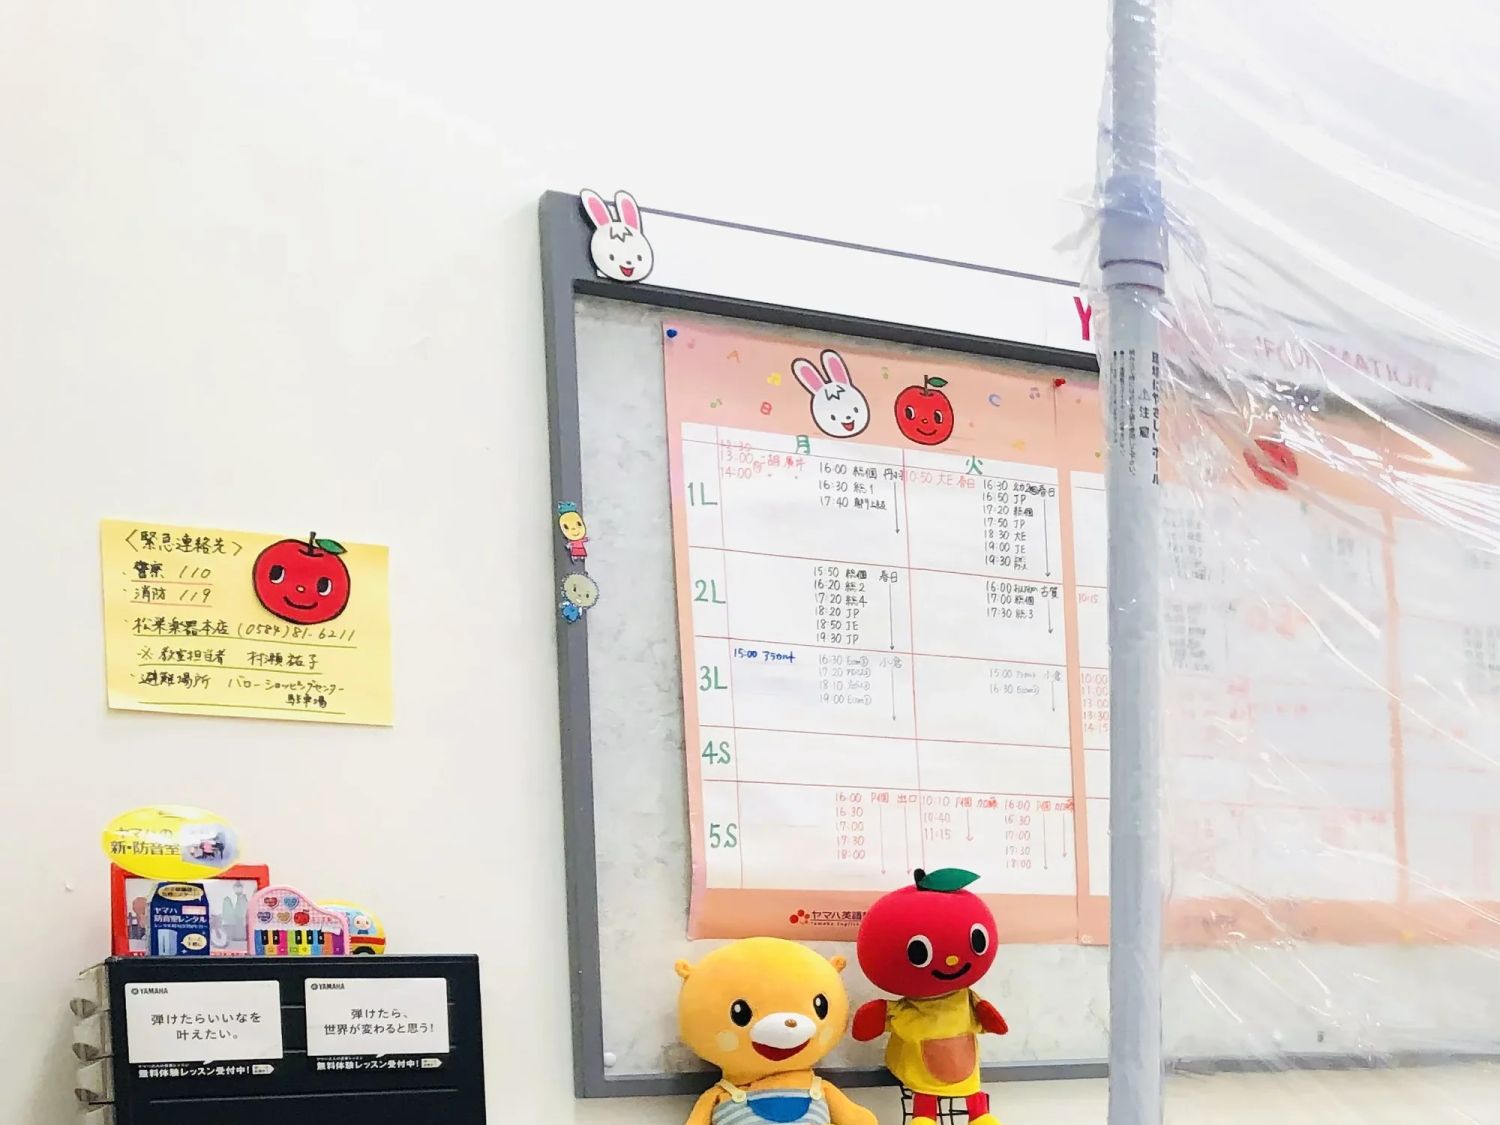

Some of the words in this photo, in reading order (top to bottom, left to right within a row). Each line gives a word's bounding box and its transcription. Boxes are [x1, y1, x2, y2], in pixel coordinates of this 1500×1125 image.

[795, 435, 810, 455] 月
[965, 456, 984, 476] 火
[688, 482, 718, 506] 1L
[179, 565, 211, 579] 110
[134, 585, 166, 602] 消防
[179, 588, 211, 603] 119
[694, 579, 726, 604] 2L
[699, 666, 728, 691] 3L
[701, 740, 731, 765] 4S
[708, 823, 738, 850] 5S
[812, 911, 866, 920] ヤマハ英語
[151, 1012, 262, 1026] 弾けたらいいなを
[176, 1029, 238, 1041] 叶えたい。
